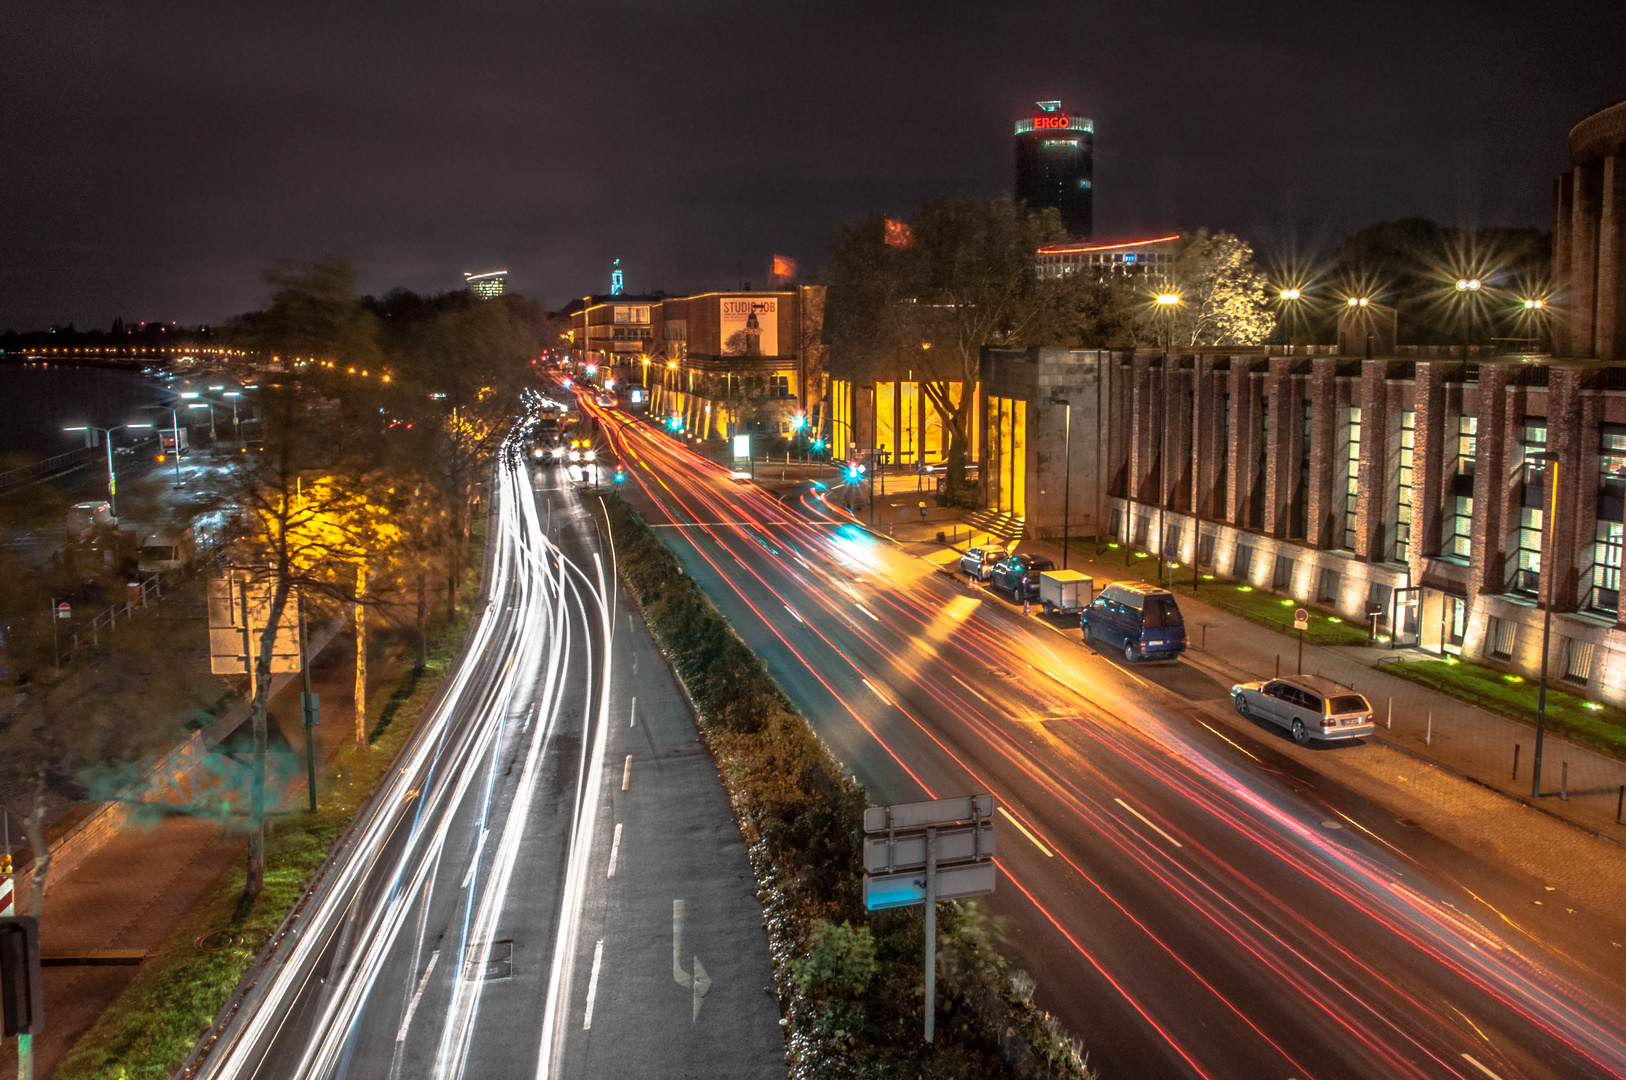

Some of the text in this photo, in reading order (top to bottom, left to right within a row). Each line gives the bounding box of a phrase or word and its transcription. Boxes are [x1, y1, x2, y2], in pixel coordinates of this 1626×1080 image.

[1034, 116, 1069, 129] ERGO
[723, 301, 776, 313] STUDIO JOB
